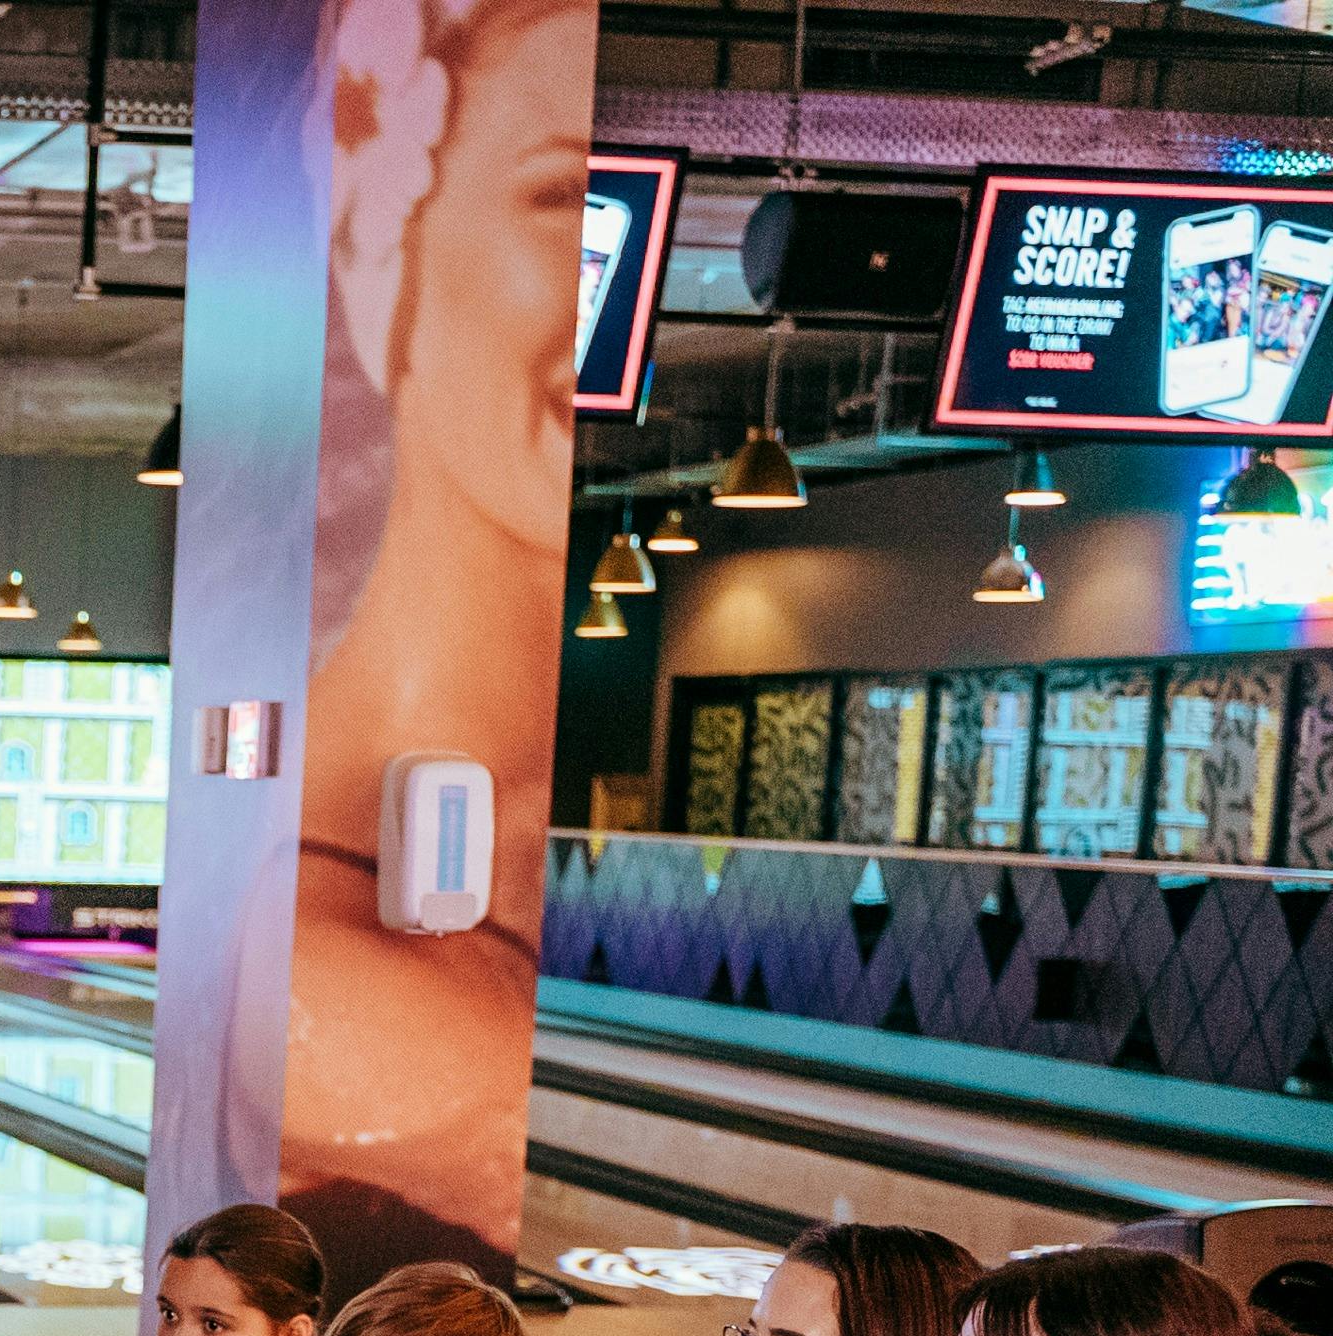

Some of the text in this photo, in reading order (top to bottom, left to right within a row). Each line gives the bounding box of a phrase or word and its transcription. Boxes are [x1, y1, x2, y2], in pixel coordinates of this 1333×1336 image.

[1021, 204, 1138, 250] SNAP &
[1013, 245, 1132, 289] SCORE!
[1006, 314, 1022, 332] TO
[1023, 315, 1040, 333] GO
[1041, 316, 1055, 333] IN
[1056, 316, 1077, 334] THE
[1029, 333, 1045, 351] TO
